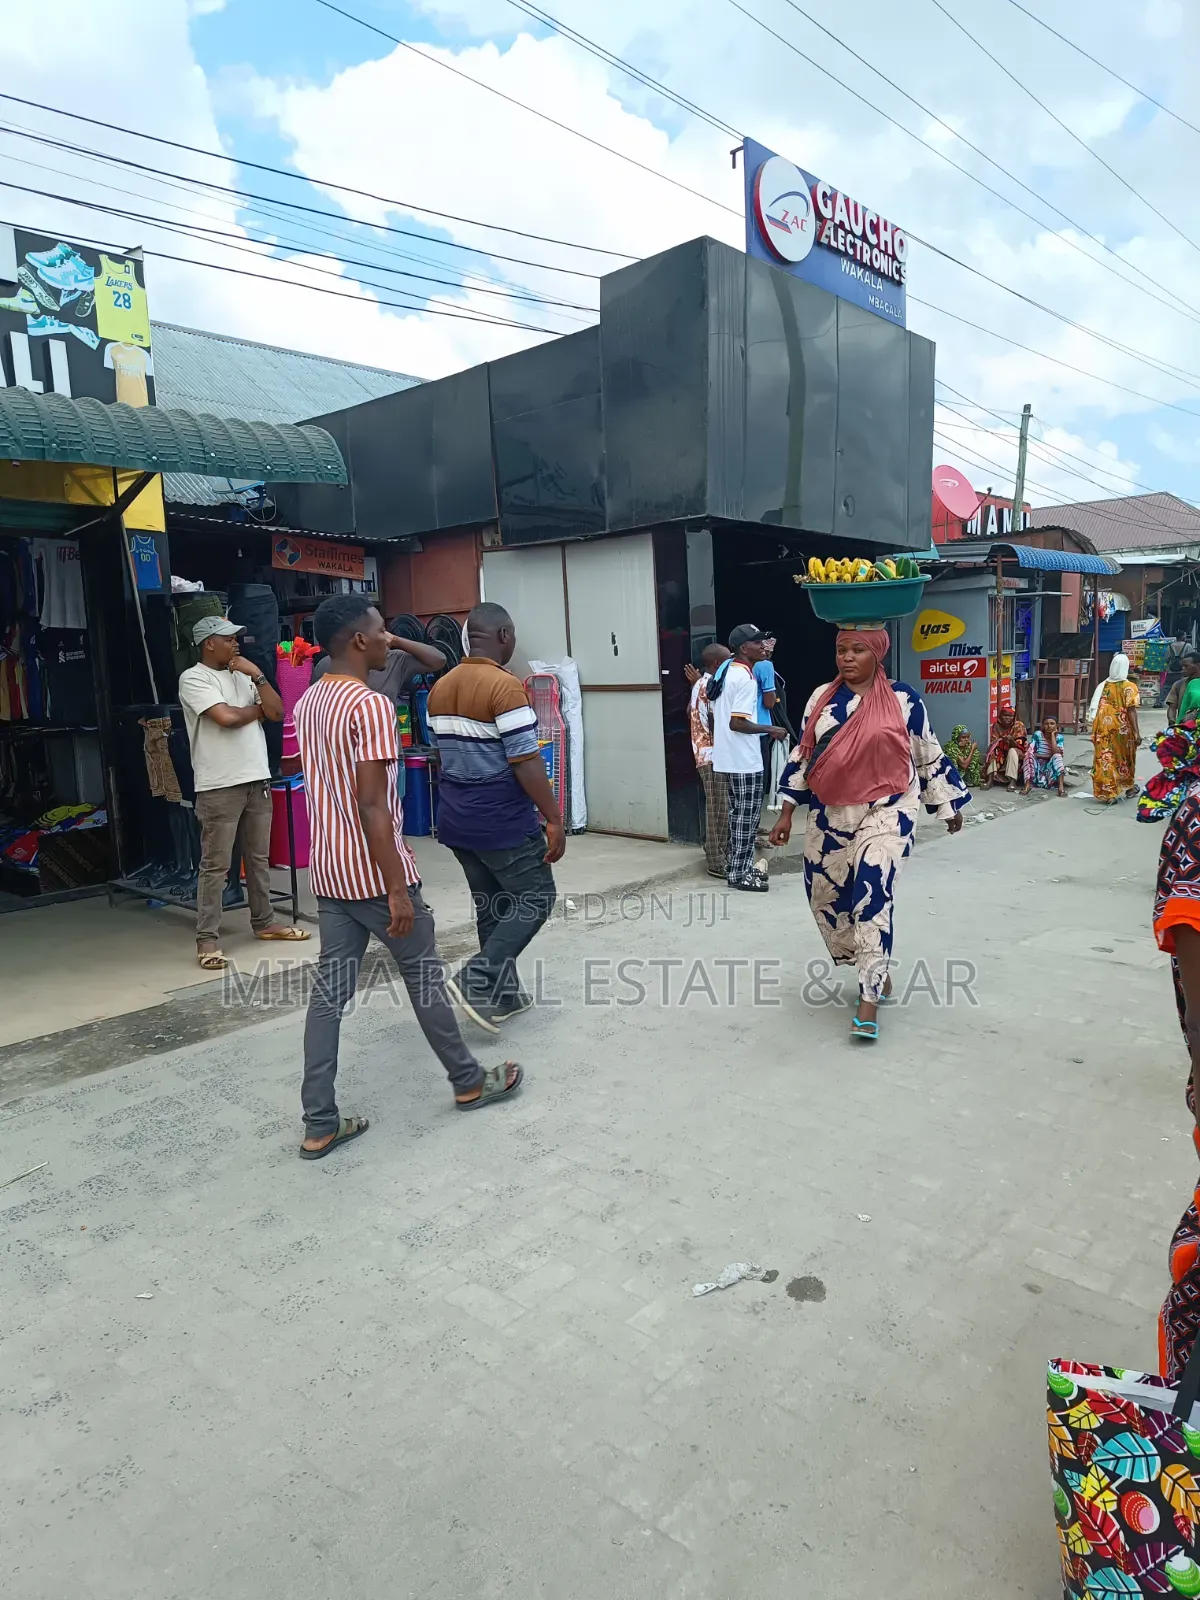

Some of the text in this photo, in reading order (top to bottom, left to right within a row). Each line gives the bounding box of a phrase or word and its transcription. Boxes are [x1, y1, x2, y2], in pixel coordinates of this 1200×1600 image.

[781, 209, 808, 233] ZAC
[814, 180, 908, 262] GAUCHO
[819, 219, 908, 285] ELECTRONICS
[841, 257, 883, 292] WAKALA
[112, 290, 132, 310] 28
[305, 543, 364, 564] StarTimes
[318, 560, 353, 573] WAKALA
[920, 623, 950, 640] yas
[948, 643, 984, 657] Mixx
[929, 661, 960, 673] airtel
[924, 680, 973, 695] WAKALA
